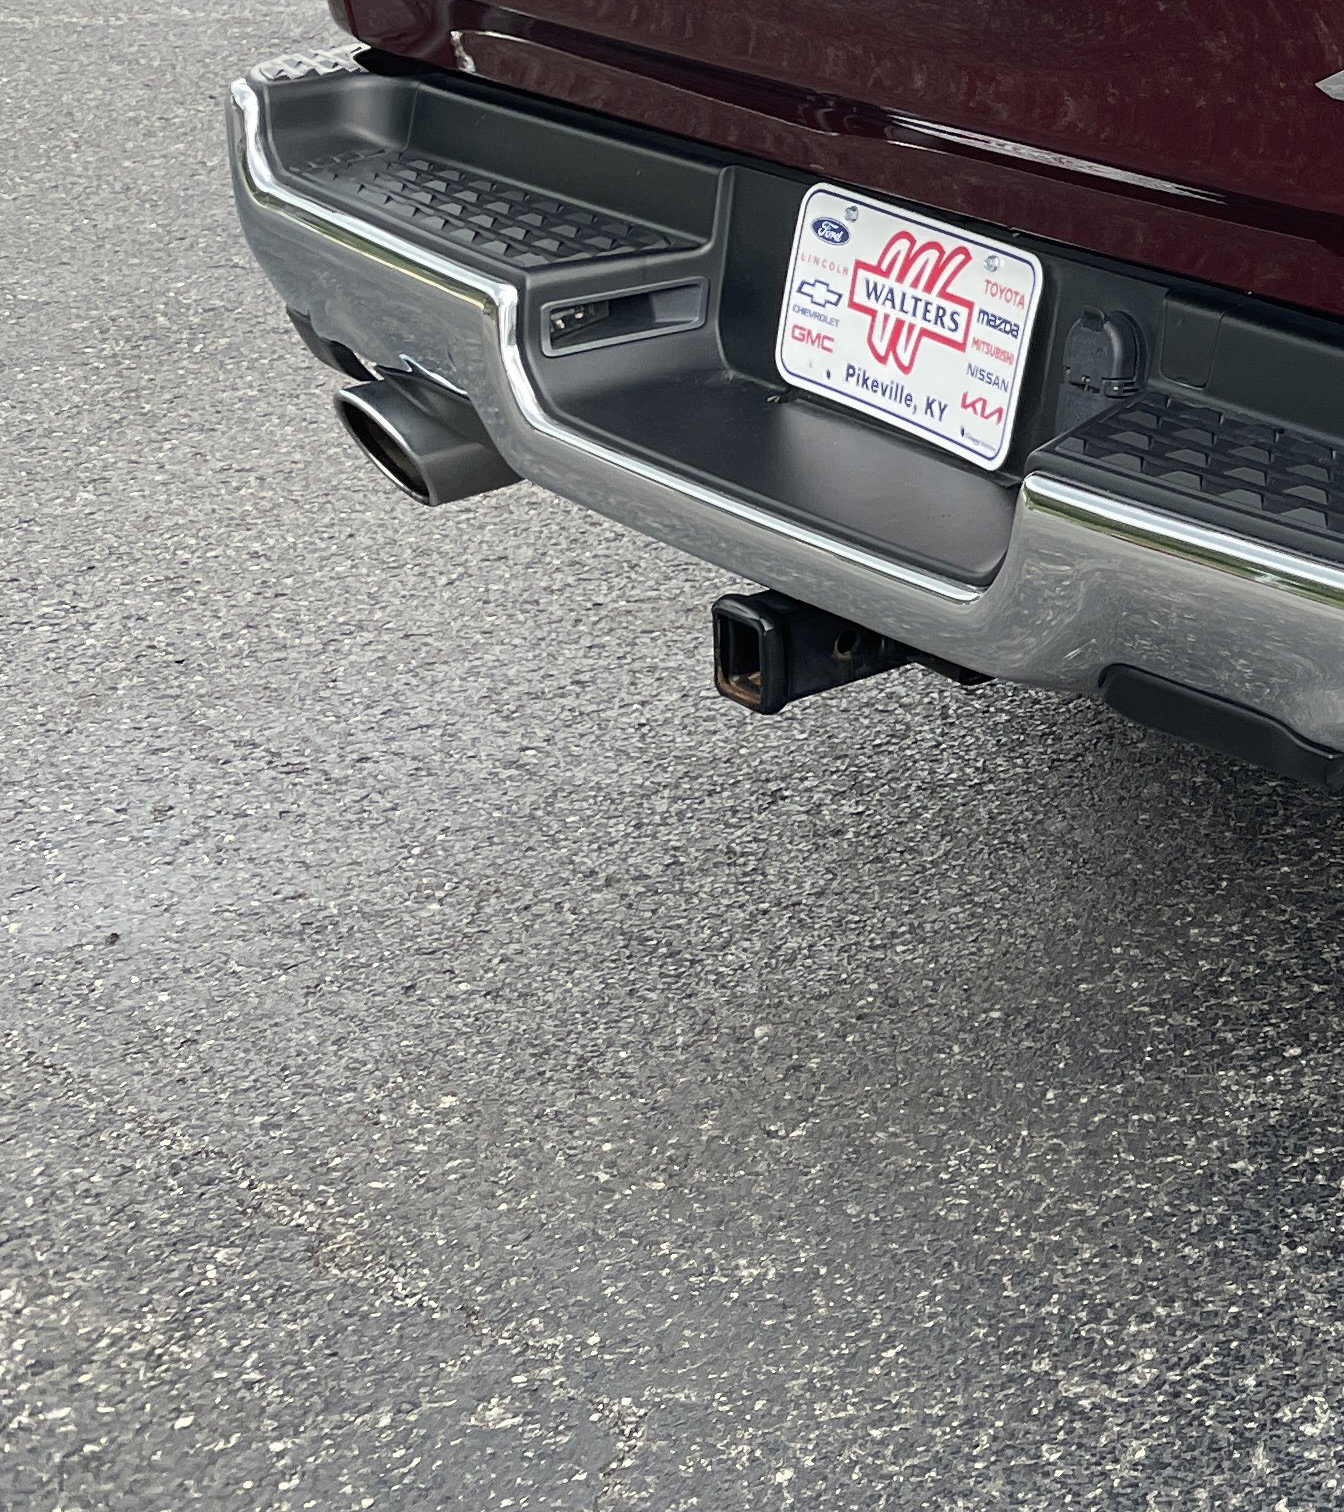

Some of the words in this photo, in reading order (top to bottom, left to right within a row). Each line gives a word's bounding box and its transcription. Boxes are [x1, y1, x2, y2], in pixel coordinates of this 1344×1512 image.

[817, 220, 844, 243] Ford
[801, 252, 849, 276] LINCOLN
[864, 277, 961, 333] WALTERS
[984, 279, 1025, 310] TOYOTA
[792, 304, 840, 328] CHEVROLET
[976, 307, 1020, 338] mazda
[791, 324, 835, 353] GMC
[971, 336, 1014, 366] MITSUBISHI
[845, 363, 917, 414] Pikeville,
[924, 395, 949, 422] KY
[966, 362, 1010, 393] NISSAN
